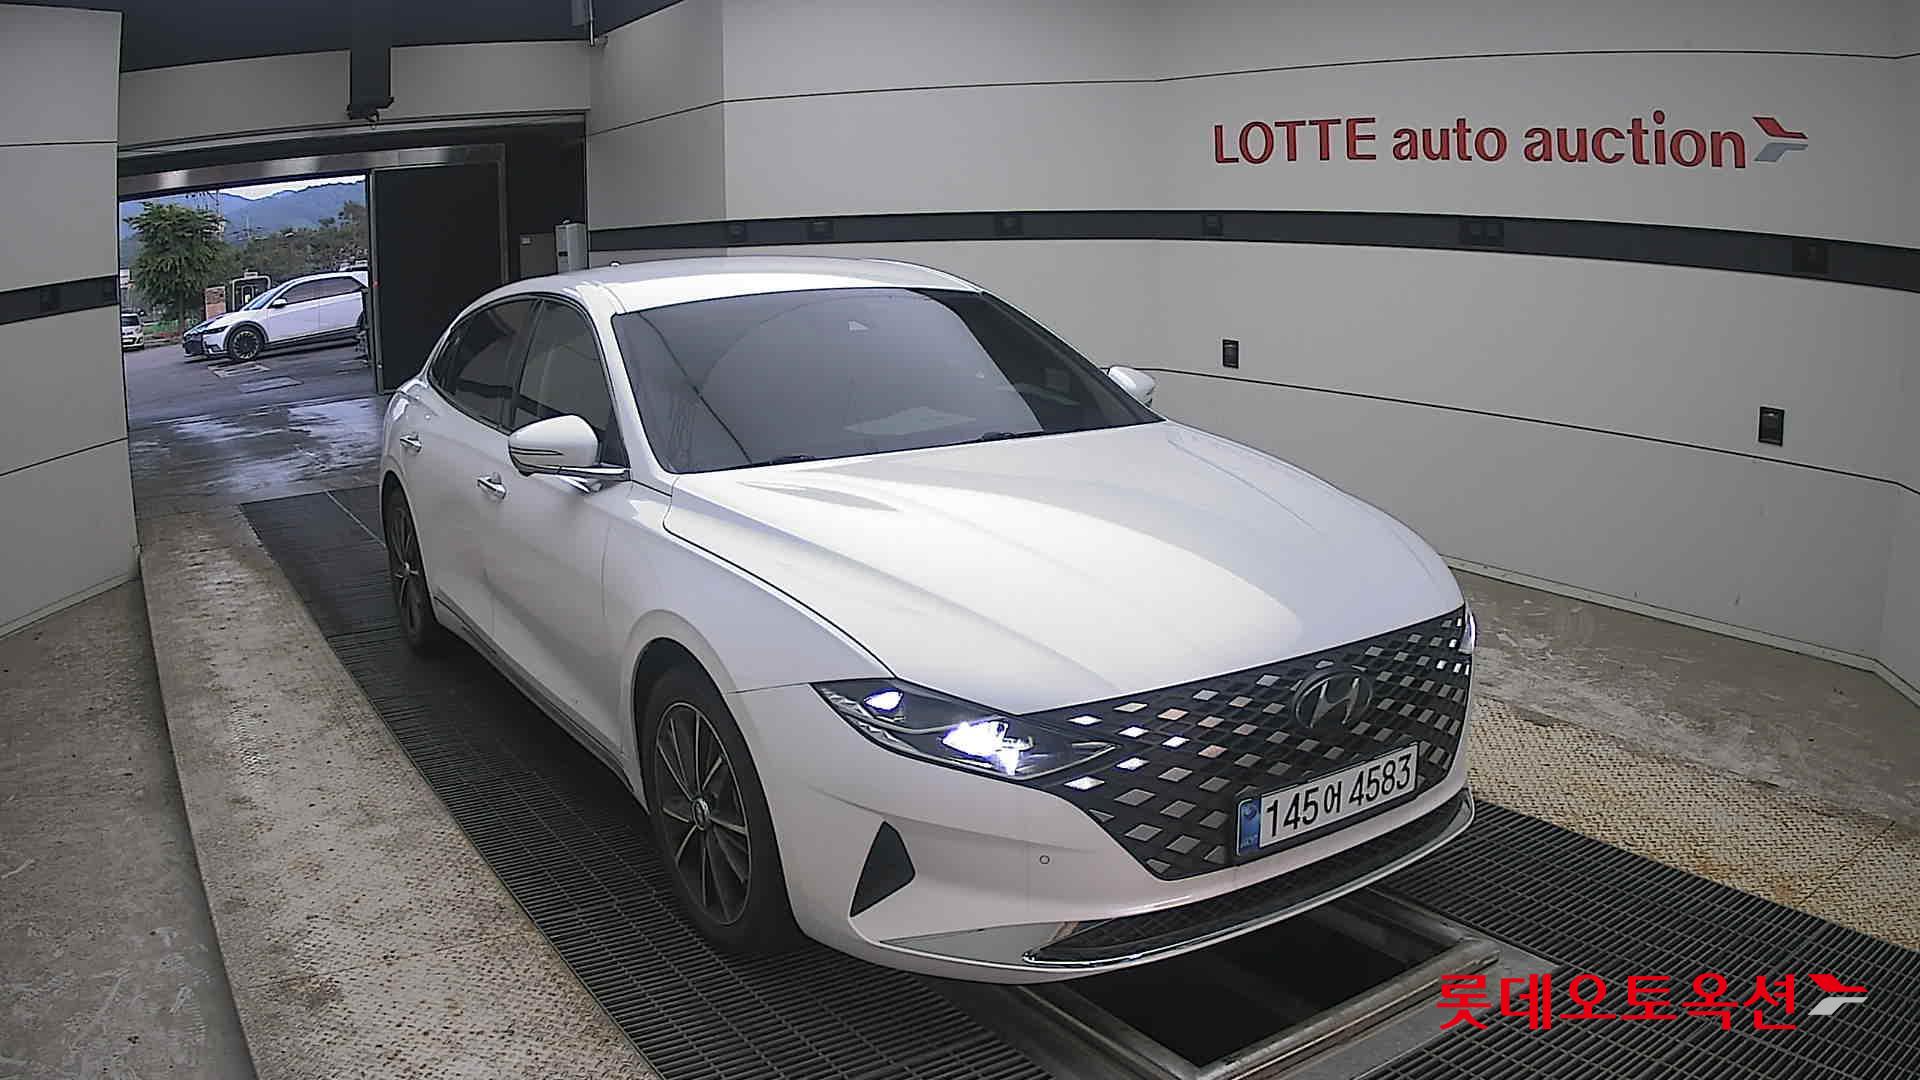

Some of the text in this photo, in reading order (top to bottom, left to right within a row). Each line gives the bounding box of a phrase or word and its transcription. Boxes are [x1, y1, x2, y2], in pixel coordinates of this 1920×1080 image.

[1213, 110, 1748, 169] LOTTE auto auction
[1266, 753, 1413, 838] 145어 4583
